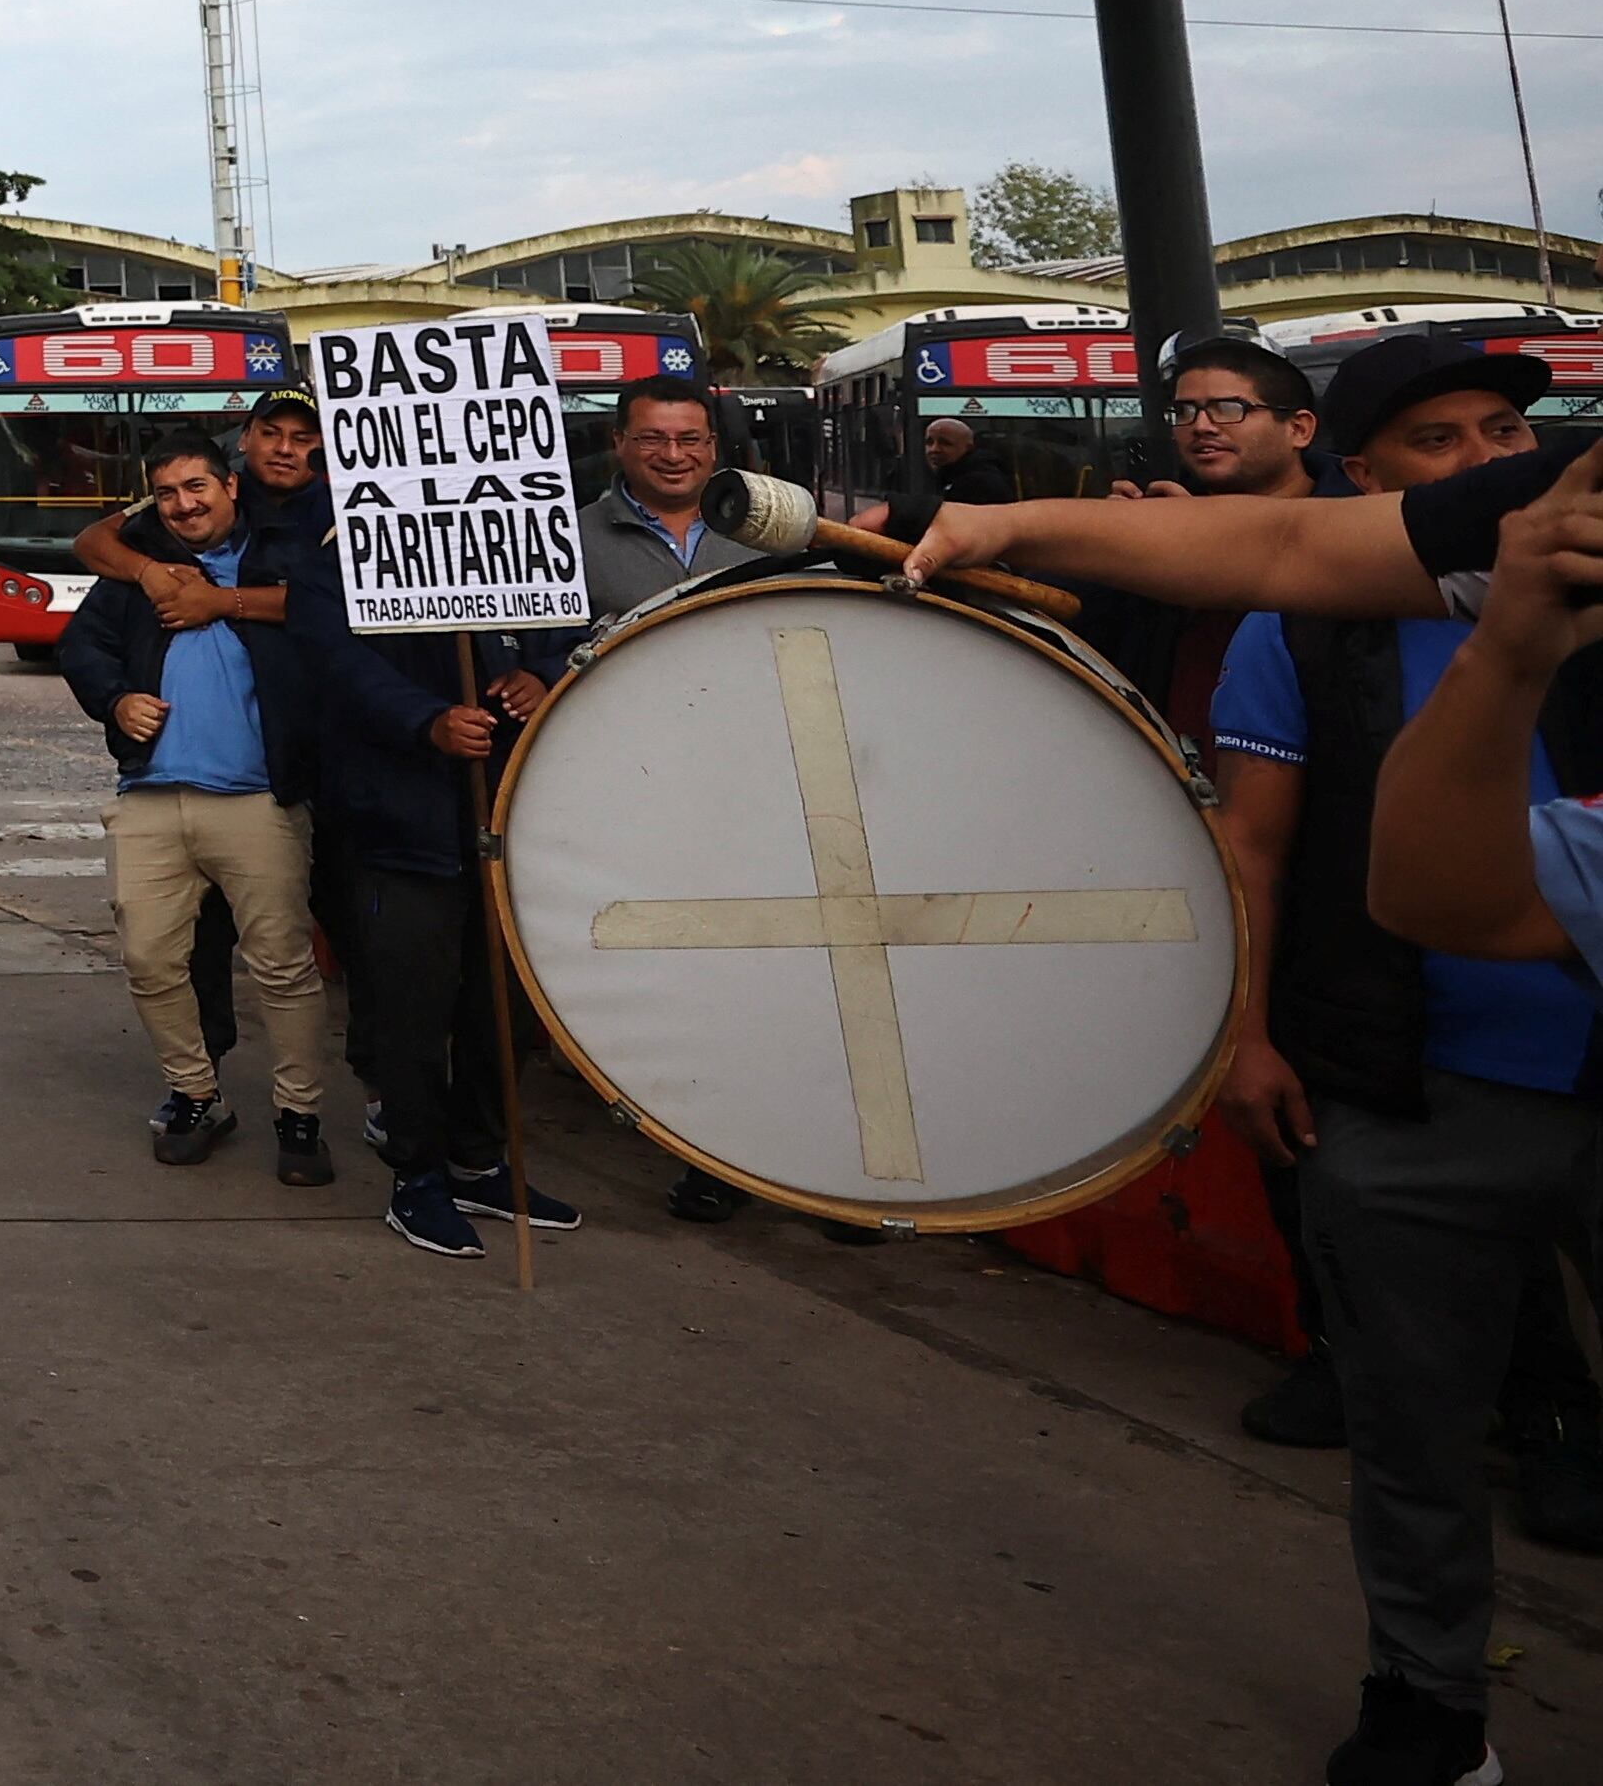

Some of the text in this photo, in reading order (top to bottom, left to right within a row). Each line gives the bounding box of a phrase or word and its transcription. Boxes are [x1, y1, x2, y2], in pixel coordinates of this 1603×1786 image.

[42, 334, 215, 377] 60
[319, 321, 552, 400] BASTA
[269, 389, 318, 411] MONSA
[333, 395, 556, 471] CON EL CEPO
[342, 470, 567, 510] A LAS
[346, 504, 577, 591] PARITARIAS
[355, 591, 583, 624] TRABAJADORES LINEA 60
